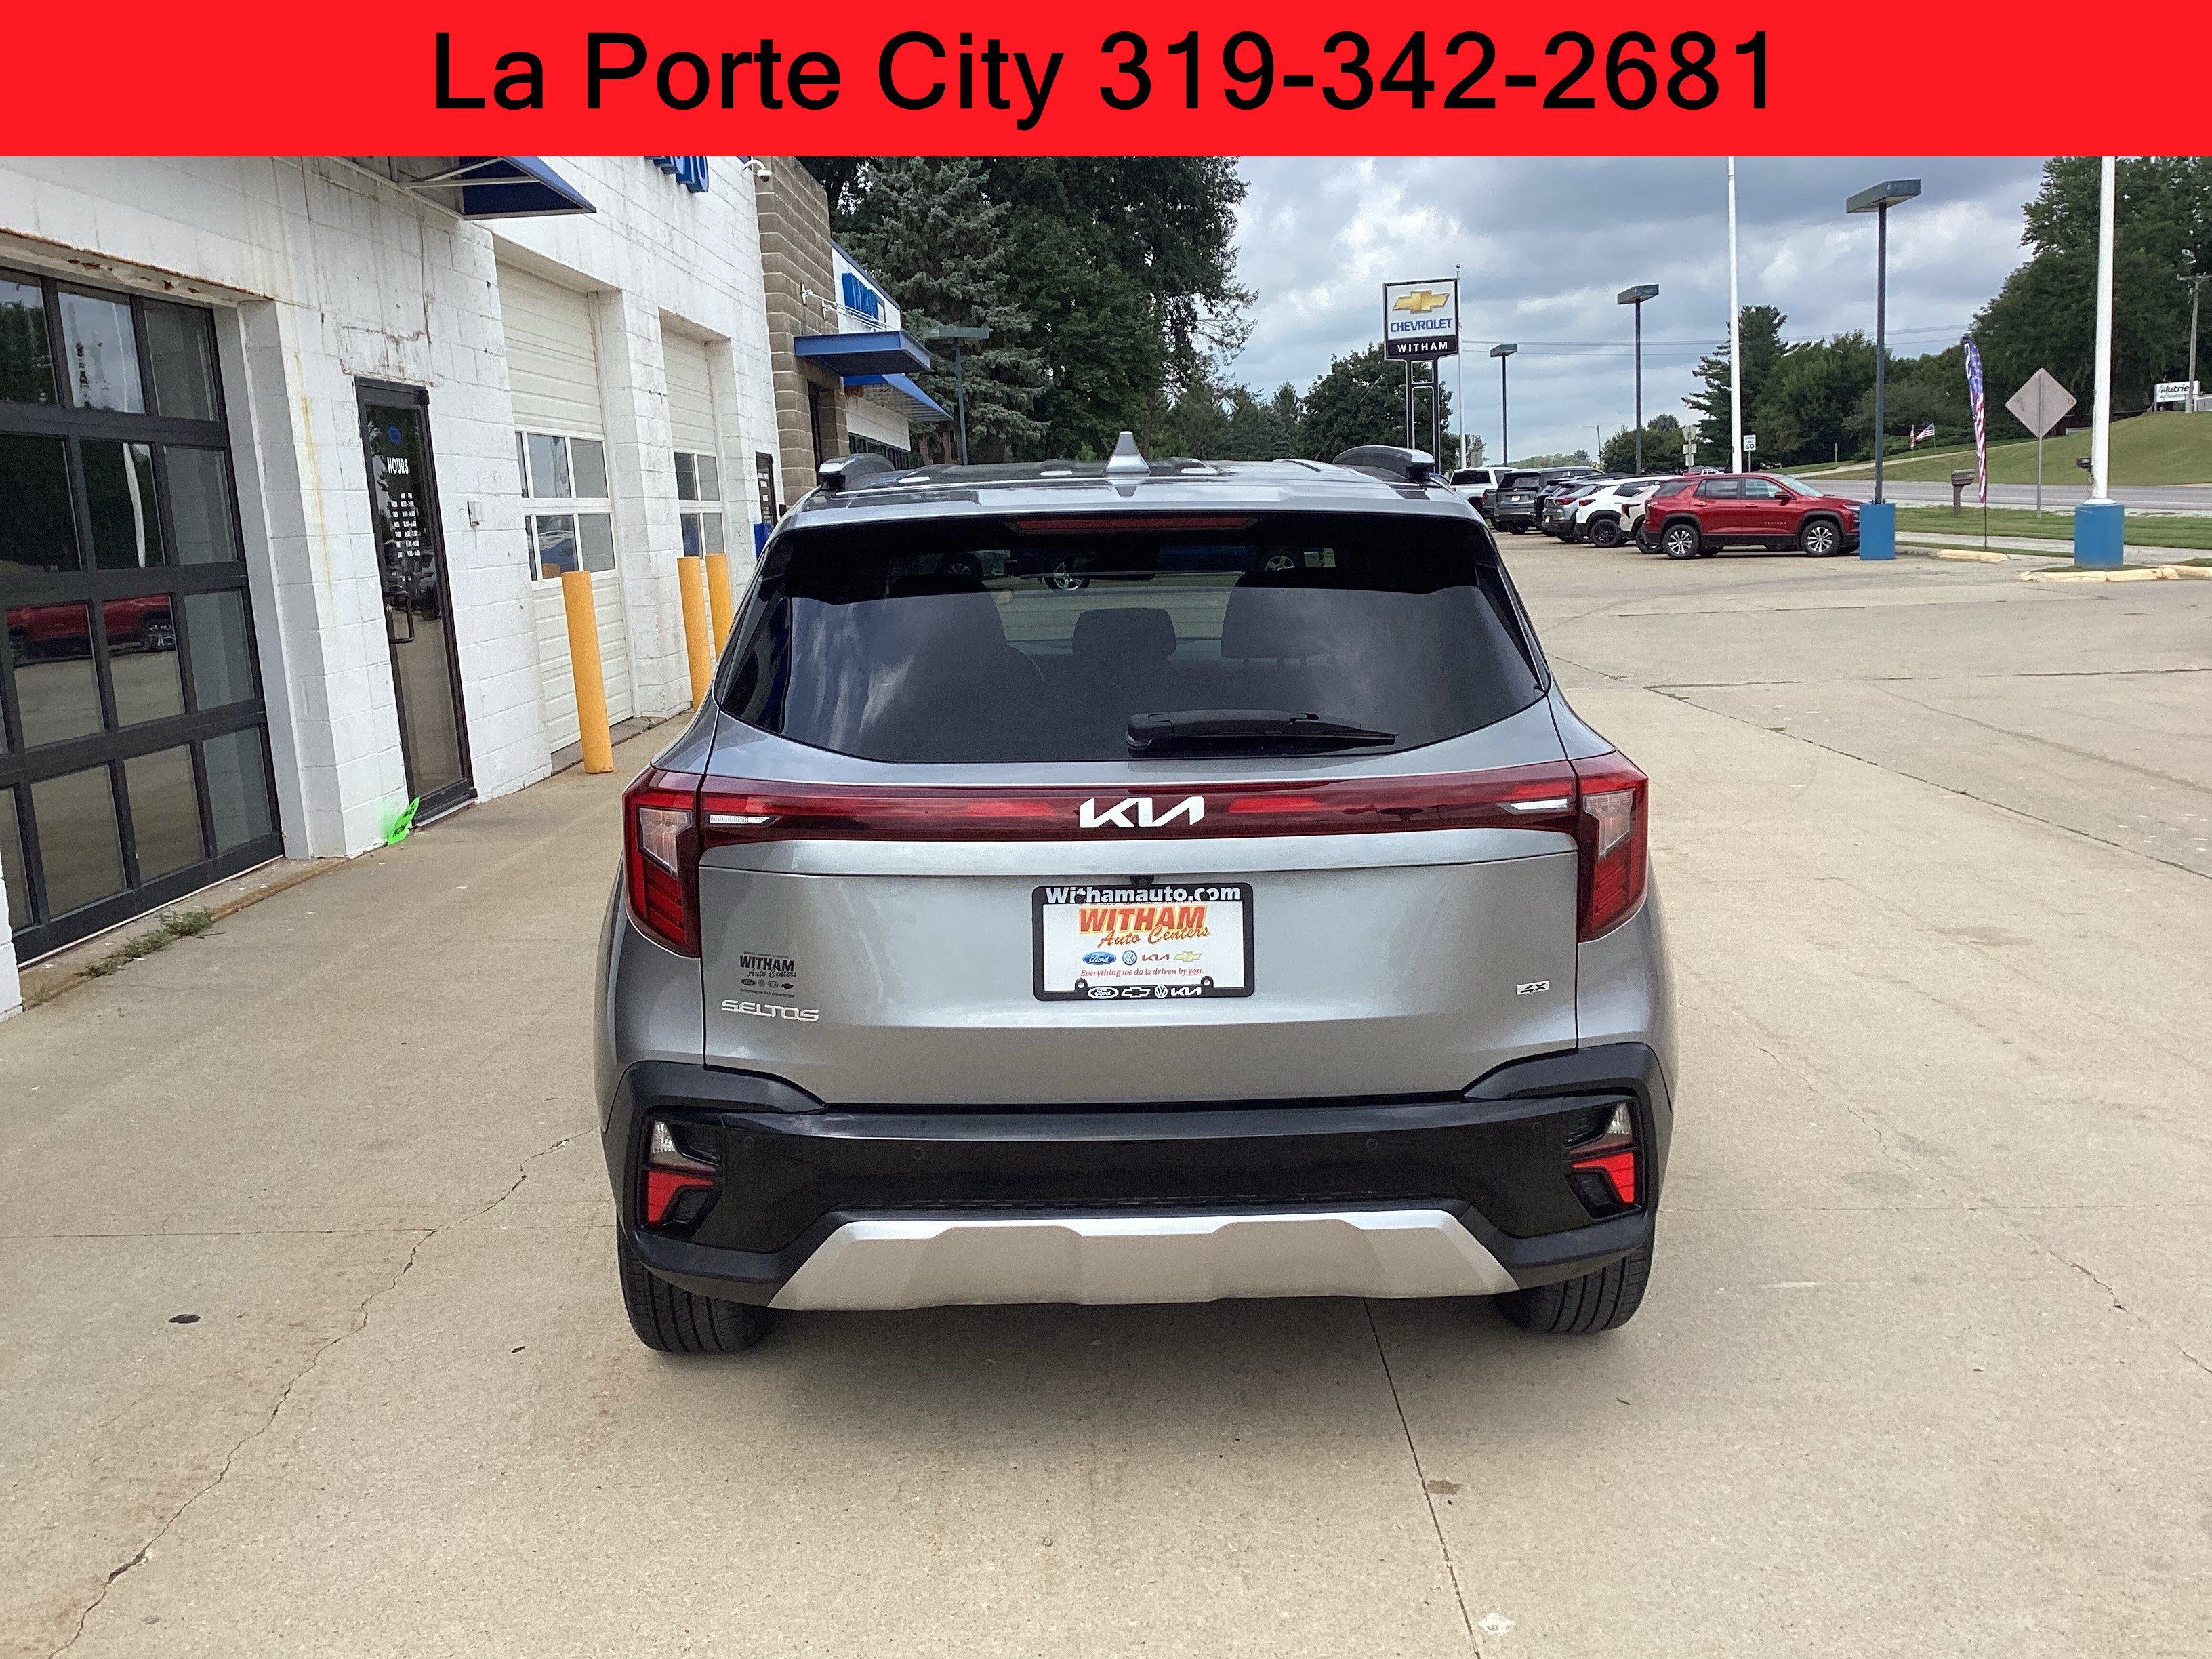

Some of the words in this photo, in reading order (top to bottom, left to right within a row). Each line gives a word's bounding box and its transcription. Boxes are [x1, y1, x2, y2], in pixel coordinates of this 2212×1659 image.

[1390, 318, 1453, 333] CHEVROLET
[1397, 341, 1448, 352] WITHAM
[2160, 384, 2190, 393] Nutrie
[387, 457, 409, 474] HOURS
[1080, 796, 1204, 828] KIA
[1045, 886, 1240, 903] Withamauto.com
[1080, 905, 1206, 933] WITHAM
[1097, 930, 1141, 948] Auto
[1147, 925, 1211, 945] Centers
[740, 955, 795, 972] WITHAM
[747, 968, 766, 977] Auto
[769, 968, 797, 978] Centers
[1080, 969, 1120, 978] Everything
[722, 999, 819, 1022] SELTOS
